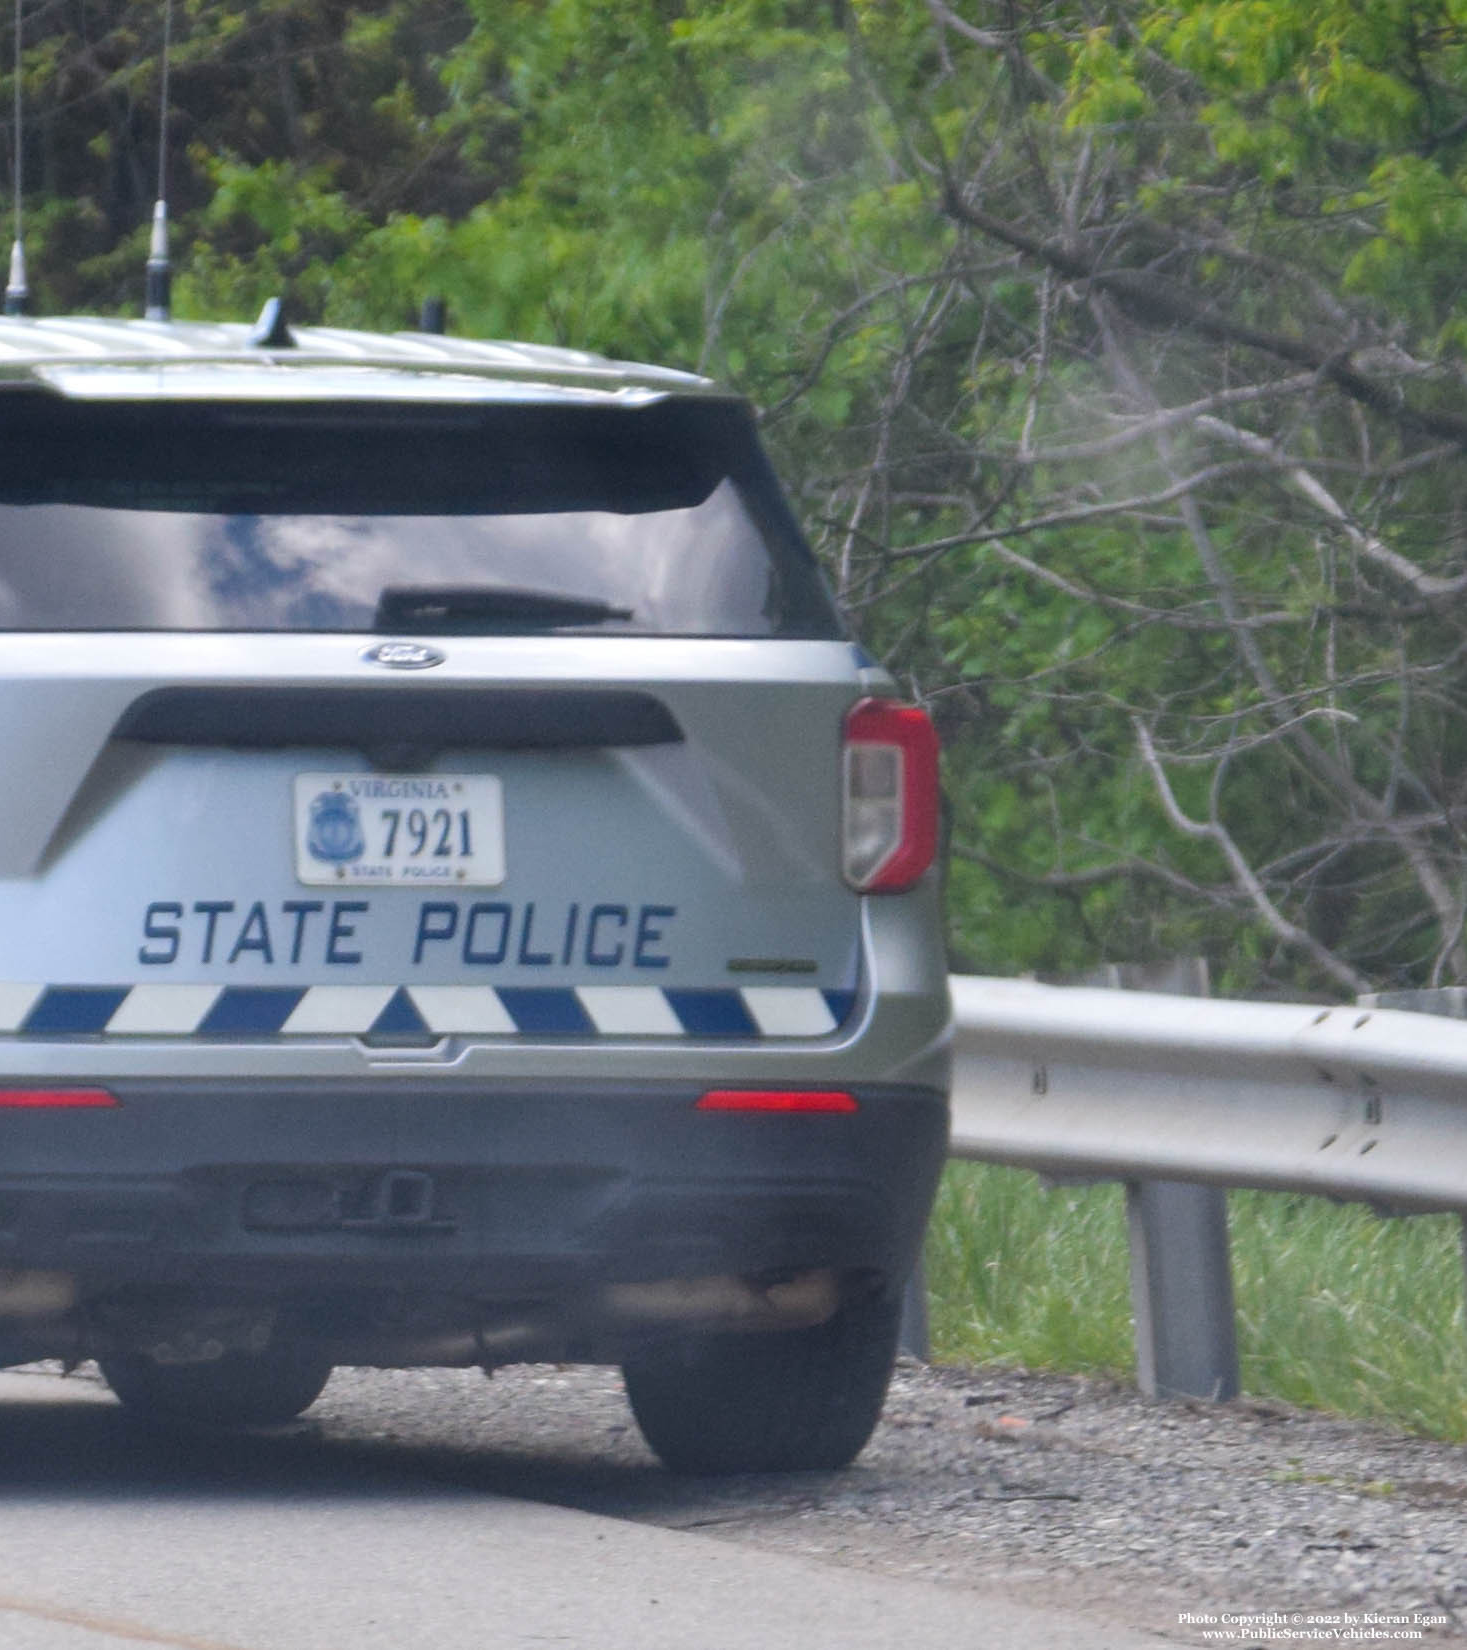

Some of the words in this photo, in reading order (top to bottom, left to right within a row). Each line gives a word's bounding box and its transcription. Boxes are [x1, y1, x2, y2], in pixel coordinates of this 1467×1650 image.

[349, 779, 449, 799] VIRGINIA
[381, 808, 474, 858] 7921
[352, 866, 393, 878] STATE
[402, 866, 451, 878] POLICE
[137, 900, 370, 966] STATE
[412, 902, 677, 969] POLICE
